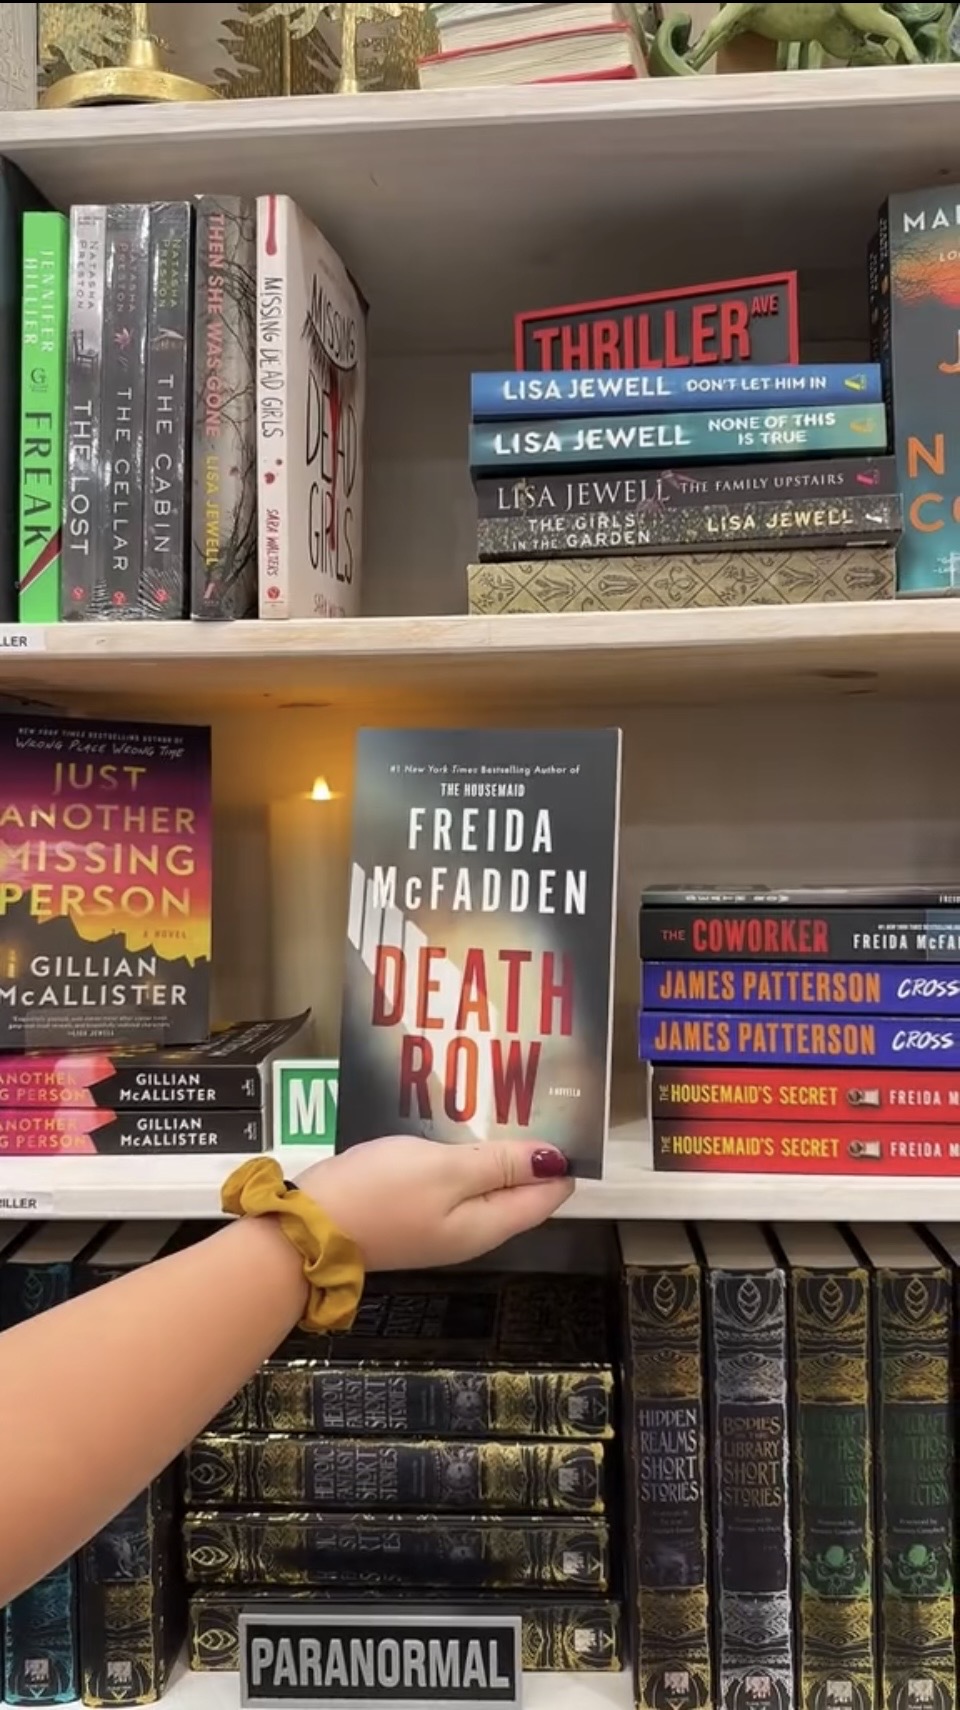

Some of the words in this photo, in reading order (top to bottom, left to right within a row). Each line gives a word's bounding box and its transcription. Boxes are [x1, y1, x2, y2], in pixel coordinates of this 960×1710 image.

[903, 204, 960, 233] MA
[208, 213, 225, 268] THEN
[87, 241, 99, 309] NATASHA
[170, 239, 182, 307] NATASHA
[24, 258, 38, 344] HILLIER
[39, 250, 54, 352] JENNIFER
[207, 275, 224, 314] SHE
[258, 277, 284, 342] MISSING
[206, 323, 224, 371] WAS
[533, 300, 751, 372] THRILLER
[751, 294, 779, 317] AVE
[258, 349, 285, 391] DEAD
[502, 379, 563, 400] LISA
[568, 375, 672, 398] JEWELL
[686, 376, 737, 392] DON'T
[740, 377, 771, 391] LET
[774, 375, 806, 390] HIM
[809, 375, 828, 389] IN
[115, 387, 132, 442] THE
[155, 374, 174, 434] THE
[205, 376, 223, 437] GONE
[260, 397, 284, 439] GIRLS
[707, 416, 760, 432] NONE
[764, 414, 788, 429] OF
[791, 411, 837, 427] THIS
[71, 400, 92, 460] THE
[493, 431, 563, 455] LISA
[572, 424, 691, 451] JEWELL
[737, 433, 754, 446] IS
[759, 430, 809, 445] TRUE
[23, 411, 52, 547] FREAK
[205, 455, 220, 494] LISA
[497, 483, 557, 511] LISA
[563, 478, 671, 512] JEWELL
[681, 480, 710, 495] THE
[715, 476, 770, 492] FAMILY
[773, 471, 846, 488] UPSTAIRS
[70, 476, 91, 555] LOST
[112, 459, 130, 571] CELLAR
[153, 453, 172, 553] CABIN
[265, 508, 280, 533] SARA
[909, 492, 960, 533] C
[205, 501, 220, 566] JEWELL
[308, 481, 353, 585] GIRLS
[528, 517, 566, 533] THE
[574, 513, 637, 531] GIRLS
[706, 515, 757, 533] LISA
[764, 509, 855, 530] JEWELL
[265, 536, 280, 577] WALTERS
[512, 540, 527, 551] IN
[532, 539, 559, 550] THE
[565, 529, 651, 549] GARDEN
[16, 738, 63, 750] WRONG
[68, 739, 107, 754] PLACE
[112, 743, 155, 757] WRONG
[159, 746, 185, 760] TIME
[53, 762, 147, 796] JUST
[390, 765, 401, 774] #1
[404, 765, 426, 774] New
[428, 765, 449, 774] York
[452, 765, 478, 775] Times
[481, 765, 531, 777] Bestselling
[534, 765, 567, 775] Author
[570, 764, 580, 775] of
[440, 782, 460, 797] THE
[463, 783, 526, 798] HOUSEMAID
[0, 803, 196, 835] ANOTHER
[408, 807, 553, 853] FREIDA
[0, 840, 195, 877] MISSING
[0, 883, 191, 919] PERSON
[372, 865, 588, 915] McFADDEN
[660, 929, 686, 942] THE
[692, 918, 829, 954] COWORKER
[853, 933, 908, 950] FREIDA
[916, 933, 960, 950] McFA
[31, 956, 156, 978] GILLIAN
[0, 984, 188, 1007] McALLISTER
[371, 944, 575, 1036] DEATH
[659, 970, 735, 1001] JAMES
[743, 971, 882, 1004] PATTERSON
[897, 978, 960, 999] CROSS
[654, 1021, 730, 1051] JAMES
[738, 1023, 876, 1056] PATTERSON
[892, 1030, 954, 1051] CROSS
[119, 1089, 217, 1102] McALLISTER
[136, 1073, 201, 1087] GILLIAN
[398, 1034, 542, 1127] ROW
[659, 1084, 669, 1102] THE
[671, 1083, 773, 1105] HOUSEMAID'S
[779, 1086, 839, 1106] SECRET
[889, 1089, 942, 1106] FREIDA
[120, 1133, 218, 1147] McALLISTER
[137, 1118, 202, 1132] GILLIAN
[660, 1136, 671, 1154] THE
[673, 1135, 775, 1157] HOUSEMAID'S
[781, 1138, 840, 1158] SECRET
[890, 1141, 943, 1158] FREIDA
[0, 1197, 37, 1209] ILLER
[638, 1408, 698, 1428] HIDDEN
[722, 1416, 782, 1436] BODIES
[641, 1430, 698, 1453] REALMS
[723, 1439, 781, 1459] LIBRARY
[641, 1456, 698, 1481] SHORT
[723, 1461, 780, 1486] SHORT
[641, 1480, 700, 1504] STORIES
[723, 1486, 783, 1508] STORIES
[250, 1637, 510, 1689] PARANORMAL
